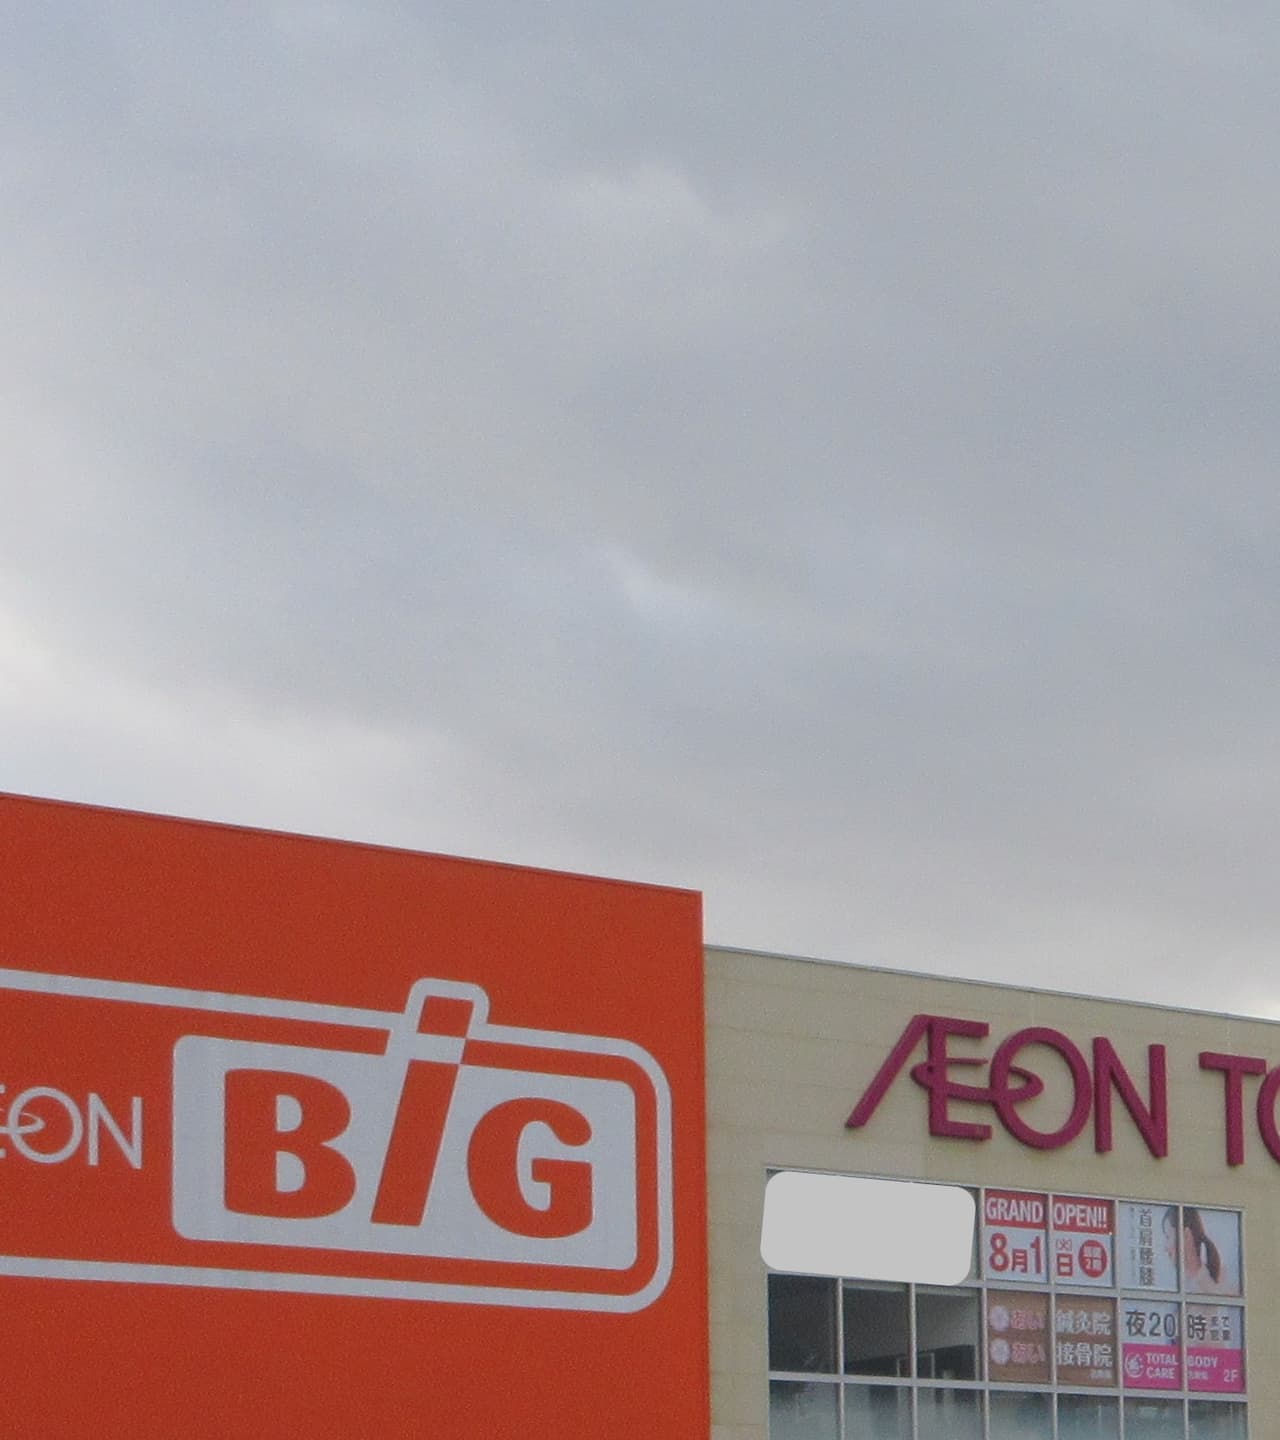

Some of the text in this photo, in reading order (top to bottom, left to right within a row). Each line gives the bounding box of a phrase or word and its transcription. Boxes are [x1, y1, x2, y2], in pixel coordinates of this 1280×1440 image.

[986, 1197, 1108, 1229] GRAND OPEN!!
[1145, 1352, 1219, 1369] TOTAL BODY
[1145, 1366, 1176, 1380] CARE
[1223, 1368, 1239, 1383] 2F
